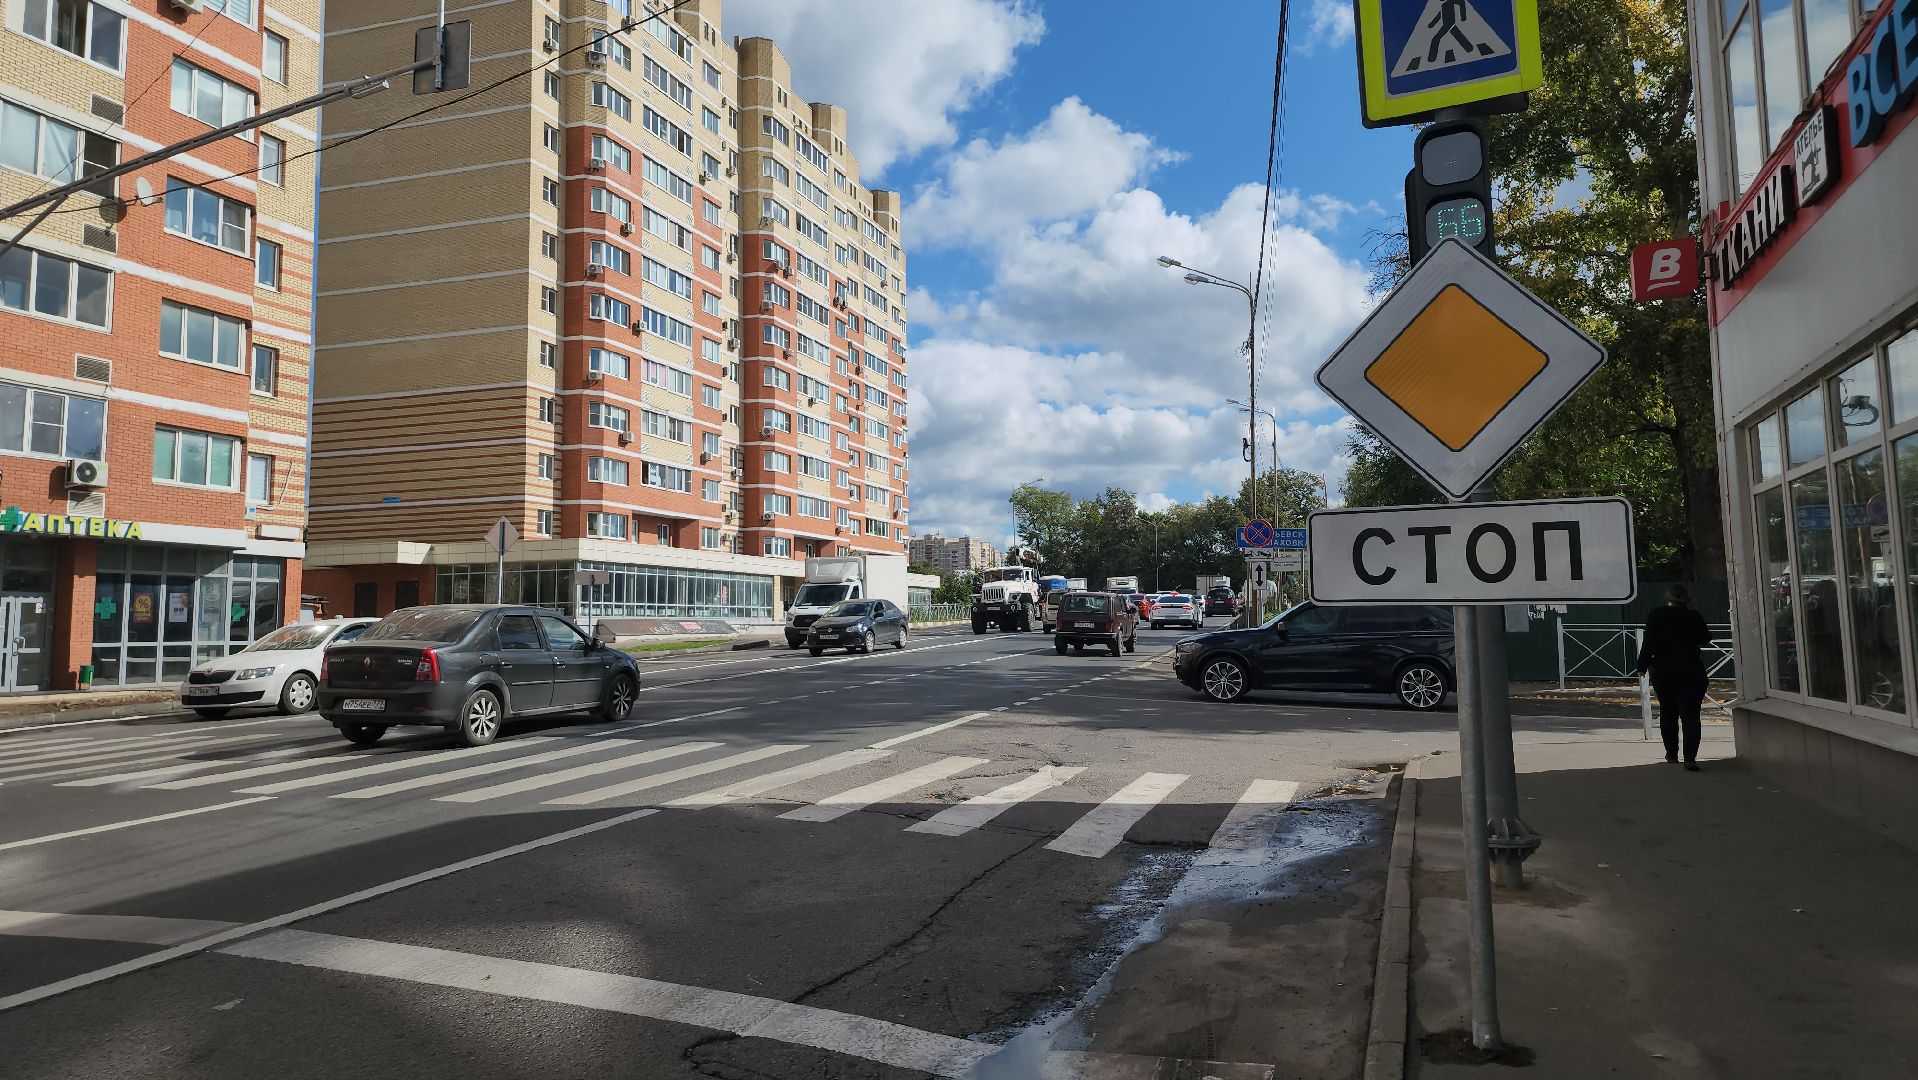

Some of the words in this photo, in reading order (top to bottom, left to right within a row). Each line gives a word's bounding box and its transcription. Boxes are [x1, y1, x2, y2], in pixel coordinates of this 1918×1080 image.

[1796, 113, 1823, 159] АТЕЛЬЕ
[1715, 168, 1785, 286] ТКАНИ
[22, 512, 144, 541] АПТЕКА
[1352, 520, 1584, 586] СТОП
